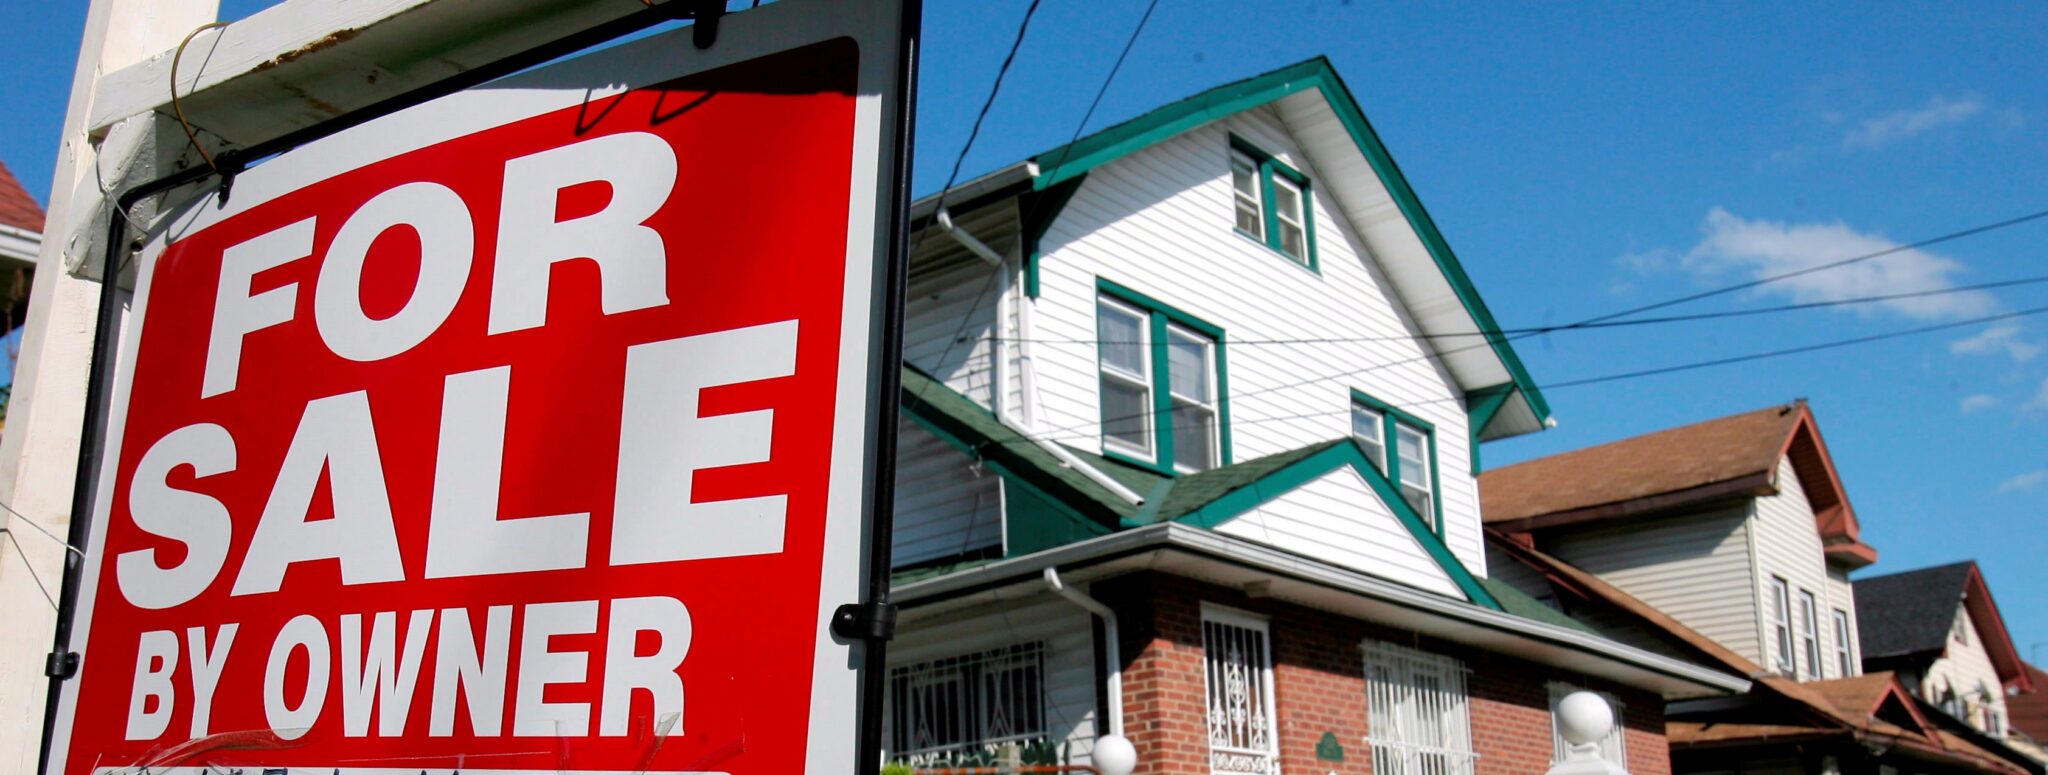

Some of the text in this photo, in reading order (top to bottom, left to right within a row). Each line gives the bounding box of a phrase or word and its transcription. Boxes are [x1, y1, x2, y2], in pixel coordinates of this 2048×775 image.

[201, 131, 678, 399] FOR
[116, 318, 799, 610] SALE
[124, 596, 693, 742] BY OWNER
